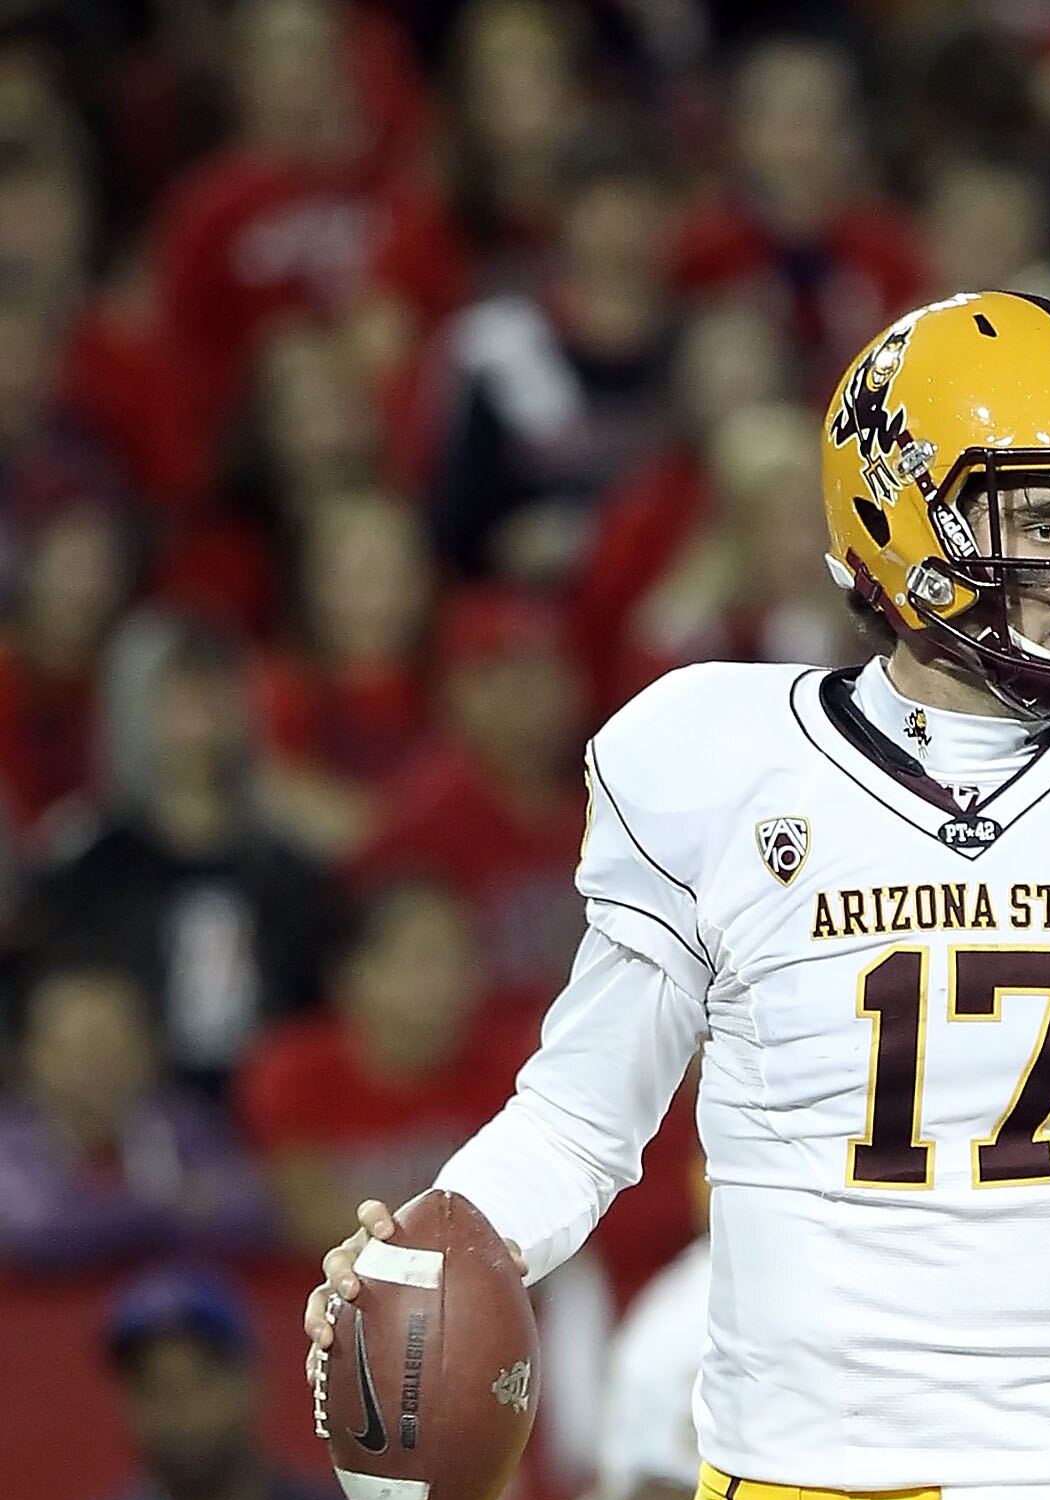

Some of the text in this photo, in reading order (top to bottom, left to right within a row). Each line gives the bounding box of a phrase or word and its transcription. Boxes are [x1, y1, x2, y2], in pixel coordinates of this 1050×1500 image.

[937, 505, 975, 557] ddell
[772, 845, 801, 873] 10
[811, 882, 1000, 940] ARIZONA
